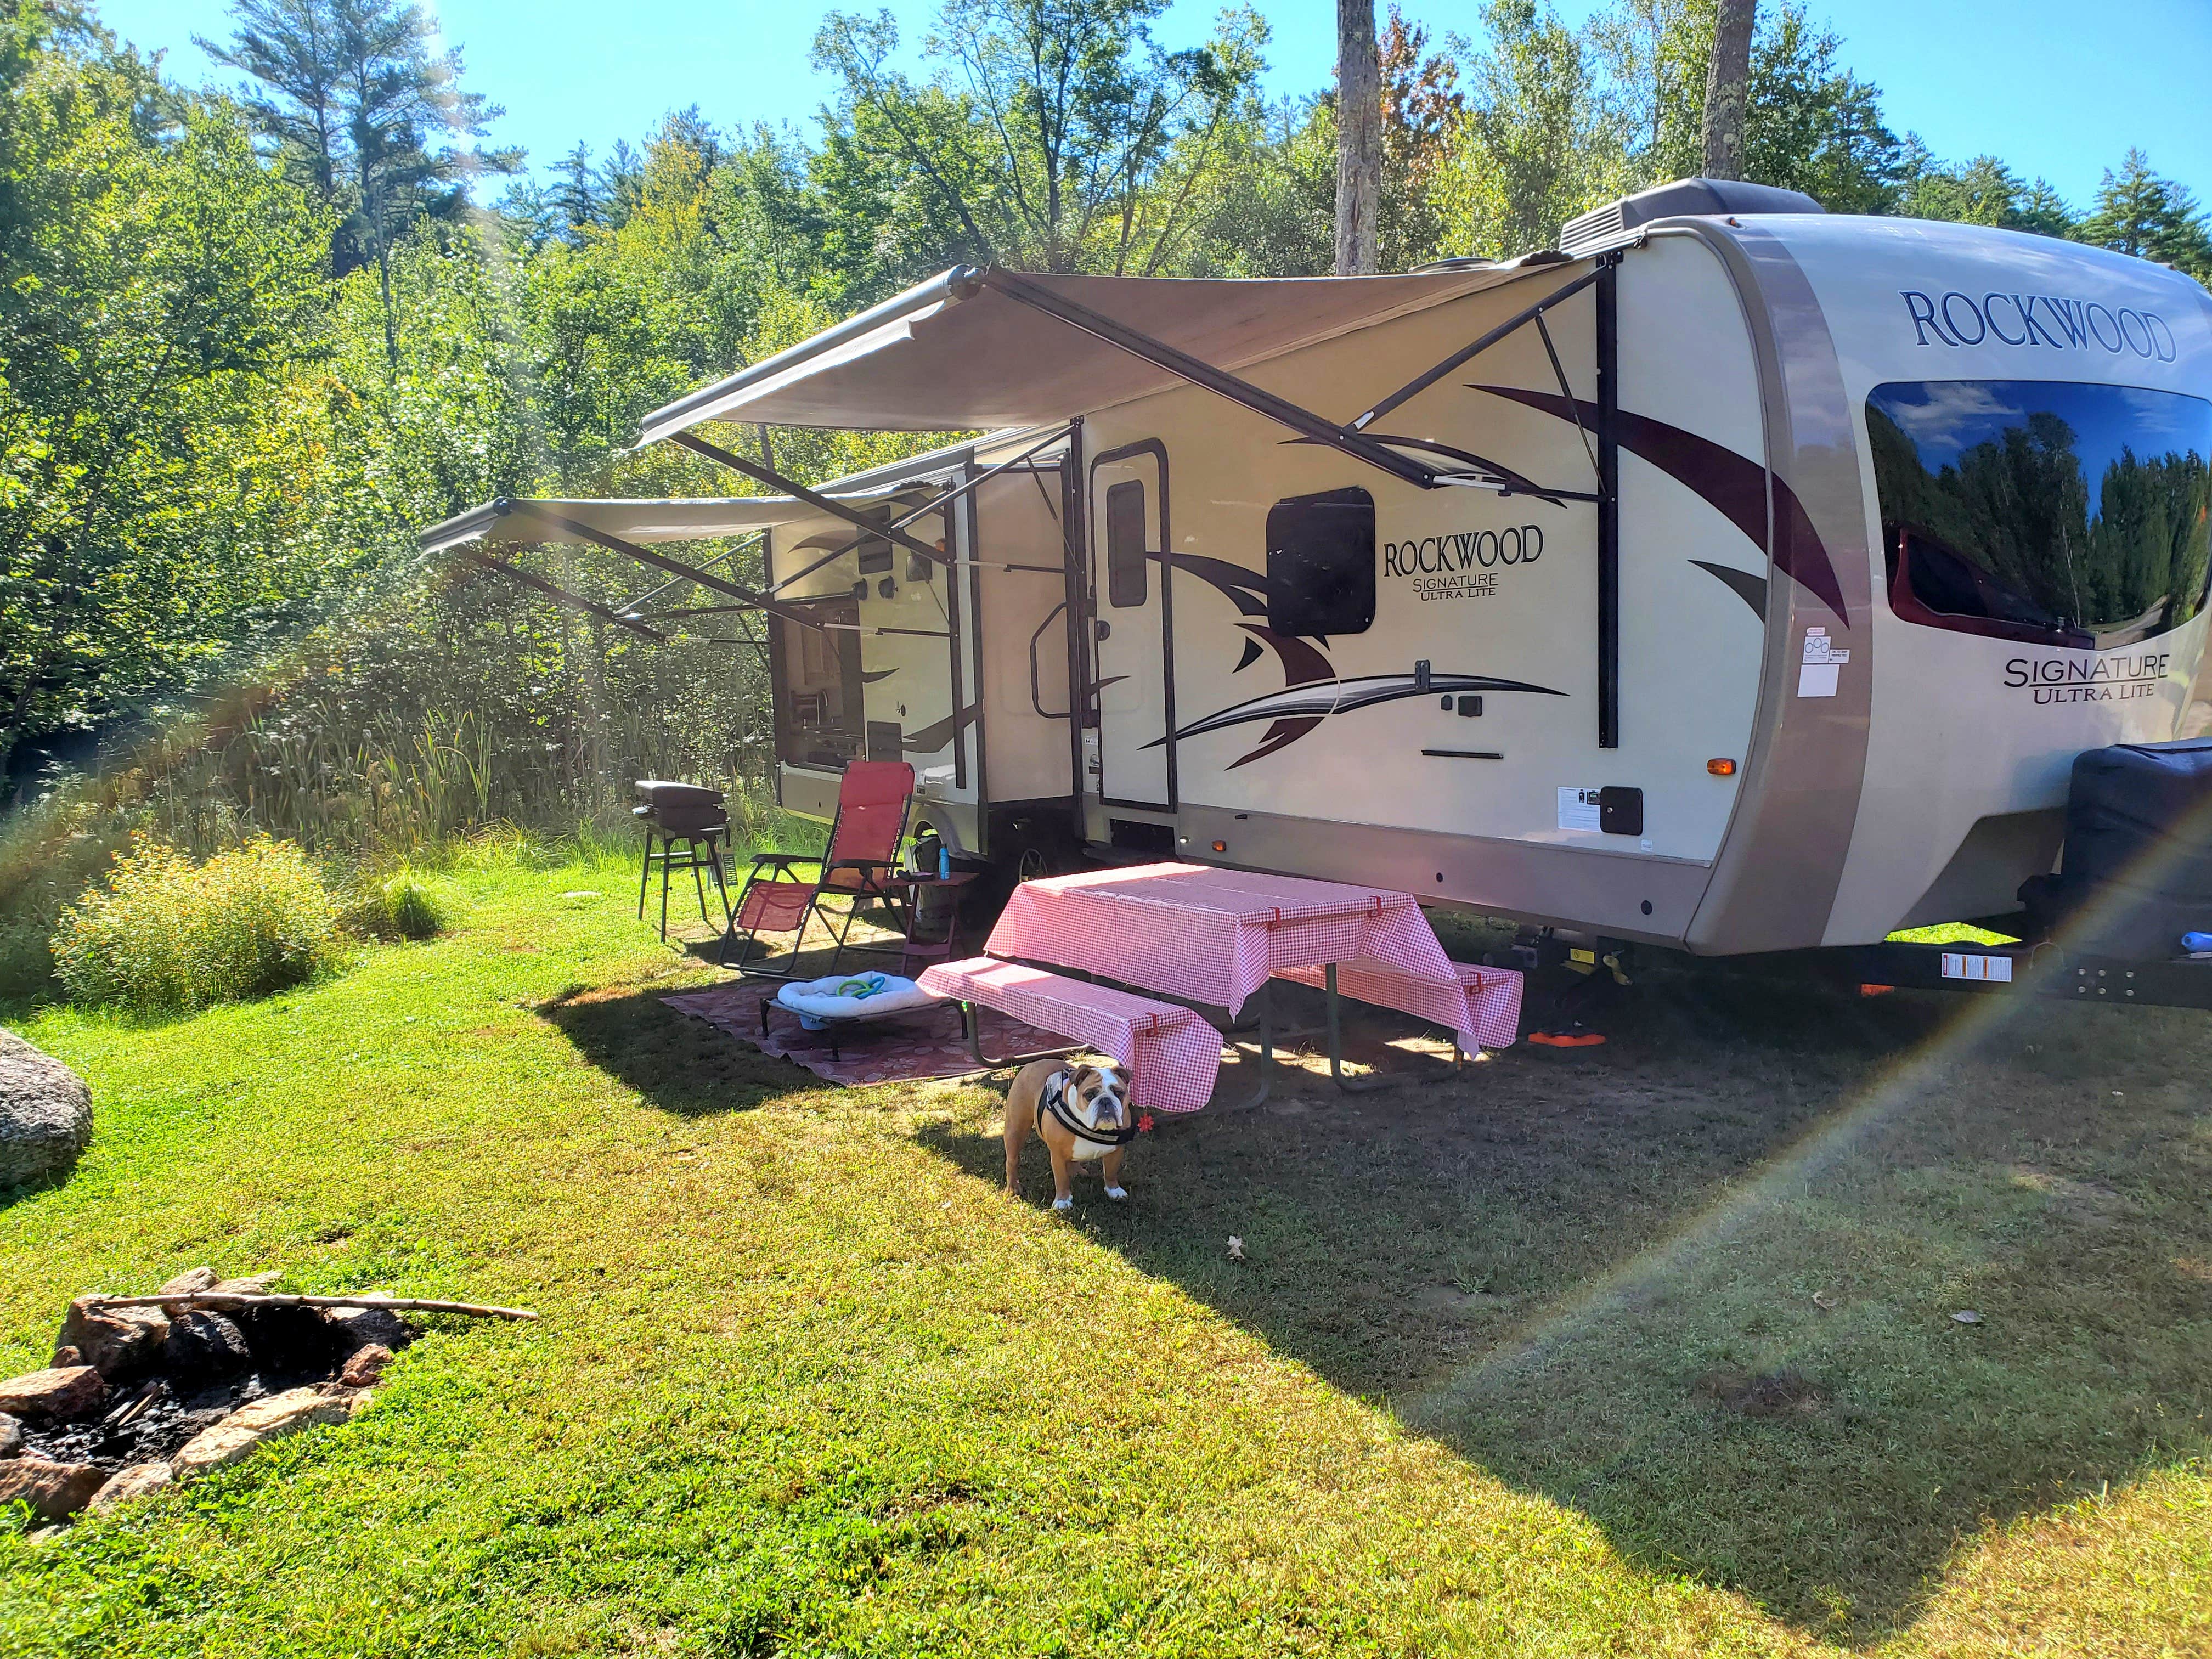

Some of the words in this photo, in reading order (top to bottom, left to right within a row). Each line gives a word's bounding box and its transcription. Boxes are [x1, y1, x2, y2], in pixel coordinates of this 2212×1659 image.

[1899, 290, 2176, 363] ROCKWOOD
[1384, 524, 1543, 577] ROCKWOOD
[1413, 573, 1498, 592] SIGNATURE
[1421, 590, 1463, 601] ULTRA
[1468, 587, 1496, 597] LITE
[2004, 654, 2170, 687] SIGNATURE
[2034, 689, 2113, 704] ULTRA
[2119, 684, 2154, 699] LITE
